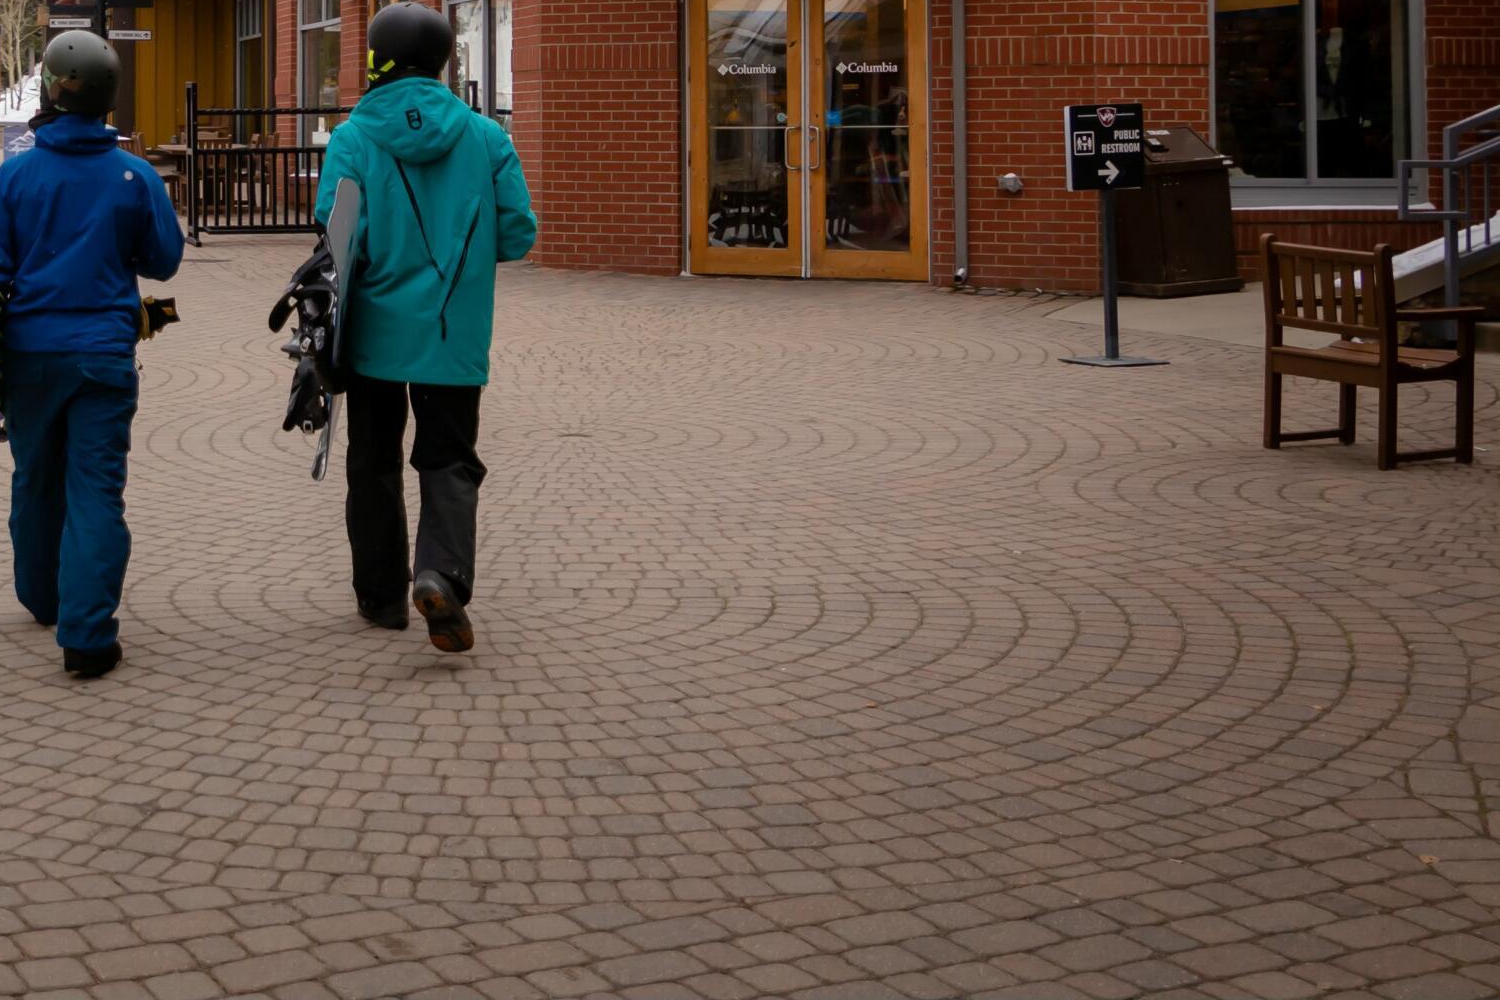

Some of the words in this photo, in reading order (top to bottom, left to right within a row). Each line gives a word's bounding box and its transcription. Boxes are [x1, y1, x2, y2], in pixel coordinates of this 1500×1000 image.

[728, 63, 776, 76] Columbia
[847, 62, 898, 74] Columbia
[1114, 129, 1140, 140] PUBLIC
[1101, 143, 1140, 154] RESTROOM
